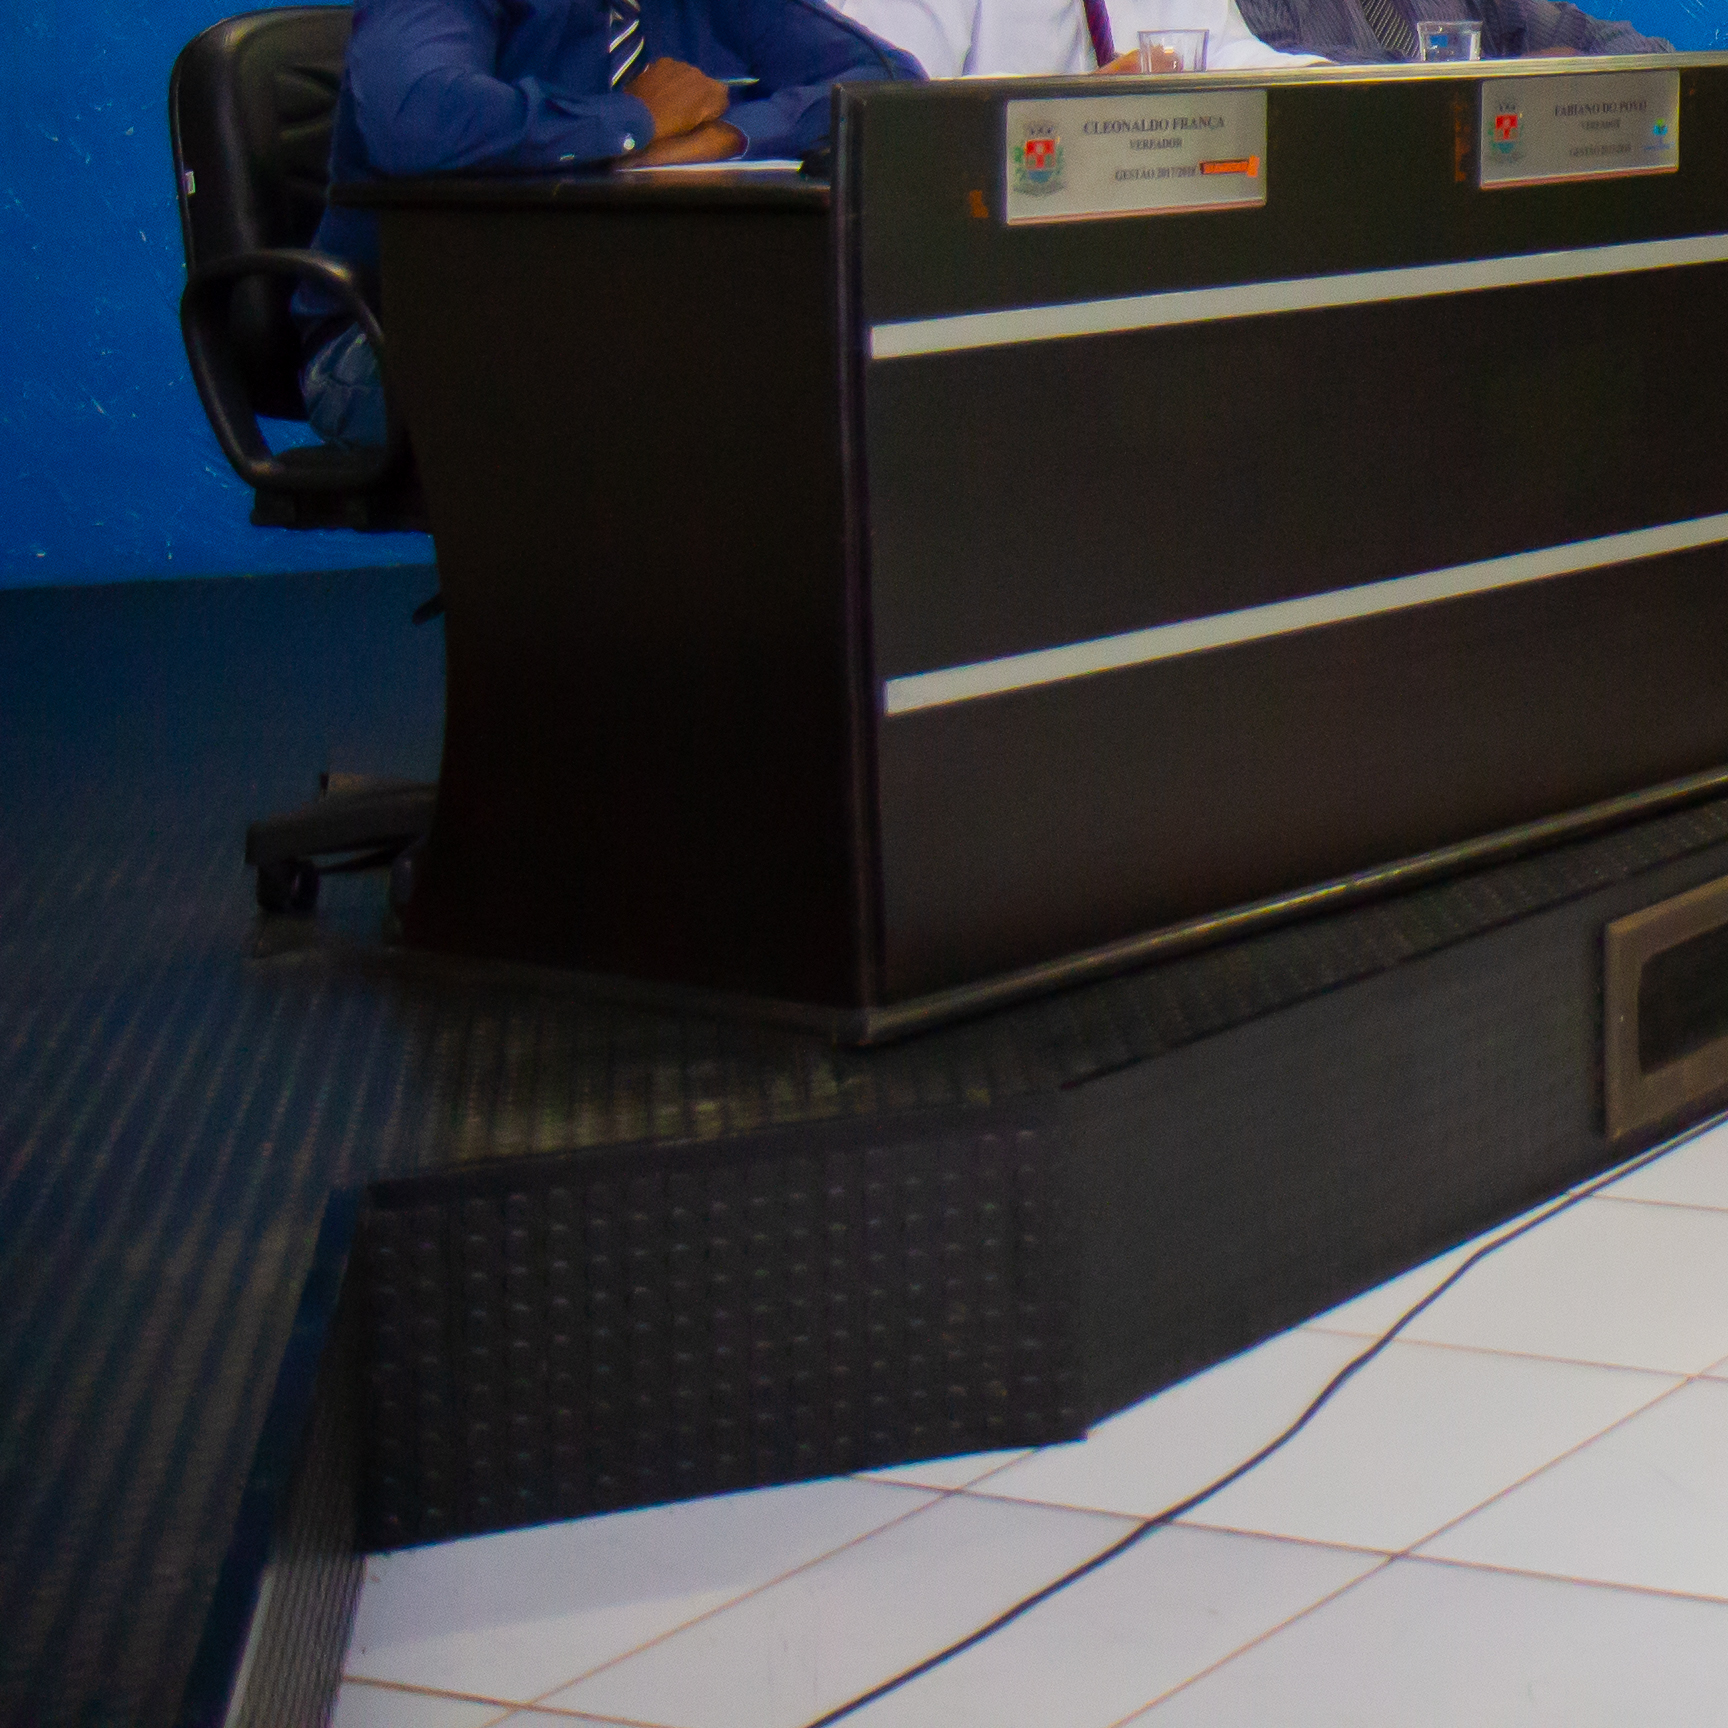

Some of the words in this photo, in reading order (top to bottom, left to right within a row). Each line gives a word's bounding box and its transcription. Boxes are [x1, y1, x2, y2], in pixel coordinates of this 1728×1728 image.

[1083, 118, 1170, 135] CLEONALDO
[1172, 116, 1225, 131] FRANÇA
[1129, 138, 1183, 150] VEREADOR
